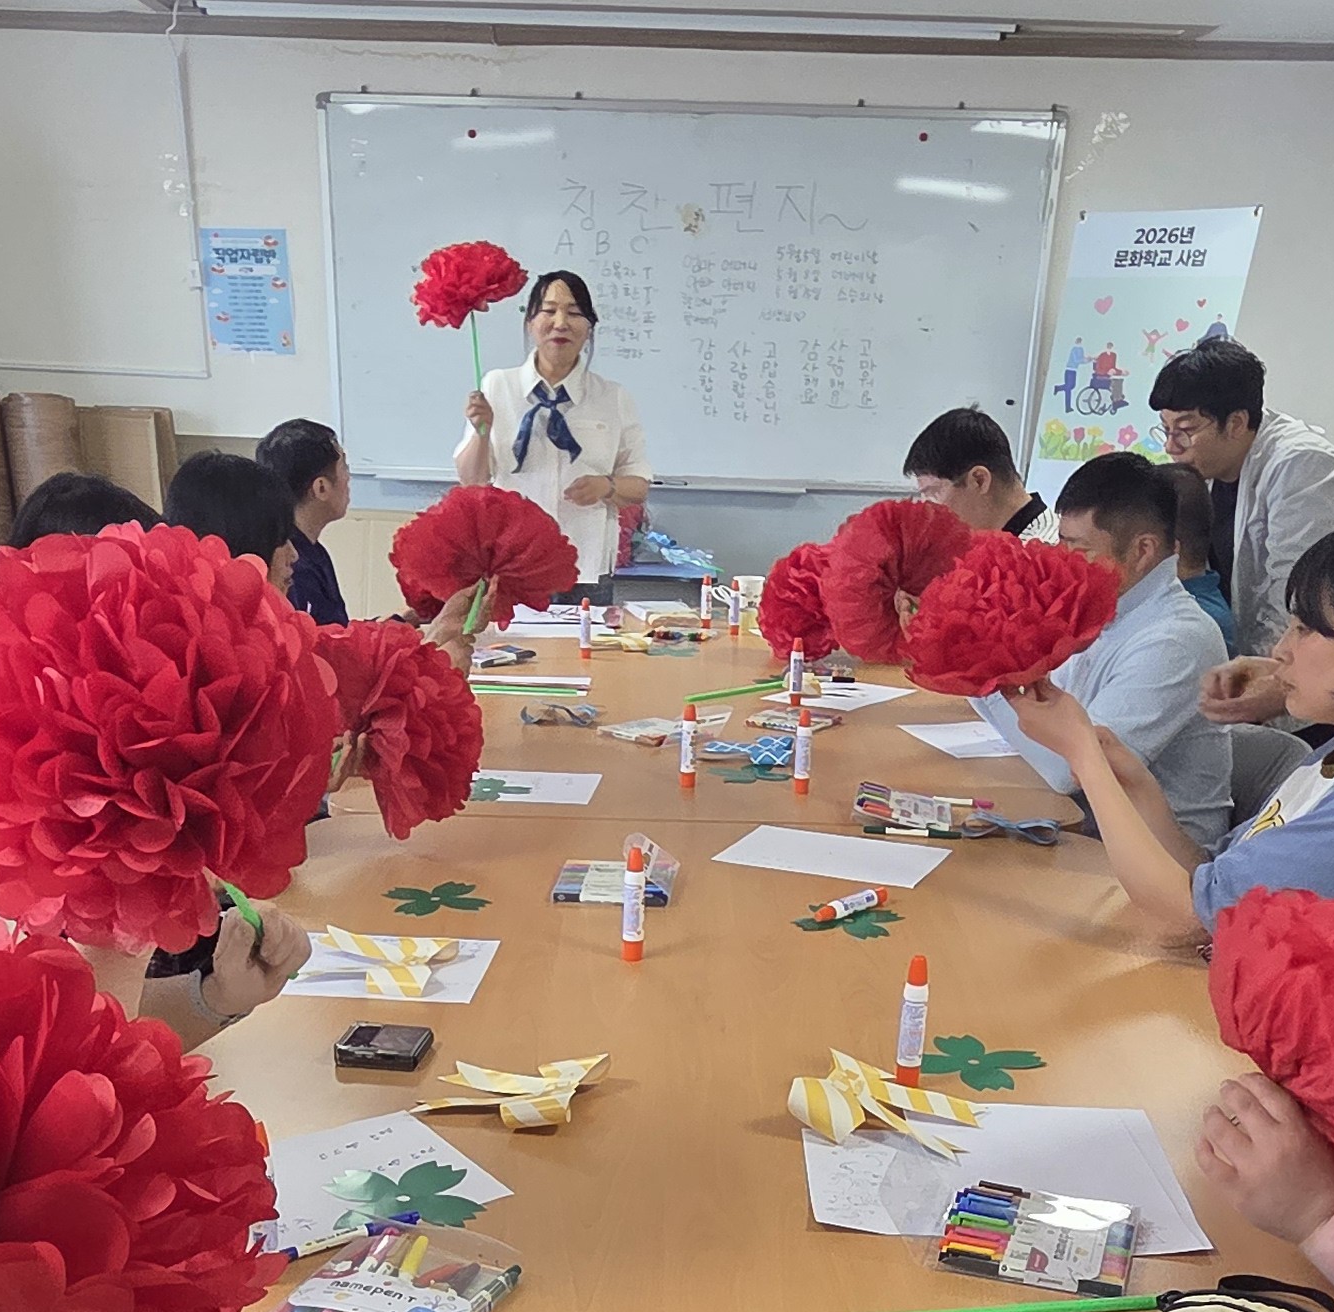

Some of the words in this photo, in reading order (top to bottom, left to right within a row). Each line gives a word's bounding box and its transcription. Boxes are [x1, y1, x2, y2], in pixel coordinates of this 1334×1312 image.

[559, 178, 673, 232] 칭찬
[554, 228, 574, 255] A
[595, 230, 610, 256] B
[630, 235, 649, 254] C
[1133, 227, 1195, 245] 2026년
[1114, 250, 1173, 268] 문화학교
[1175, 249, 1207, 267] 사업
